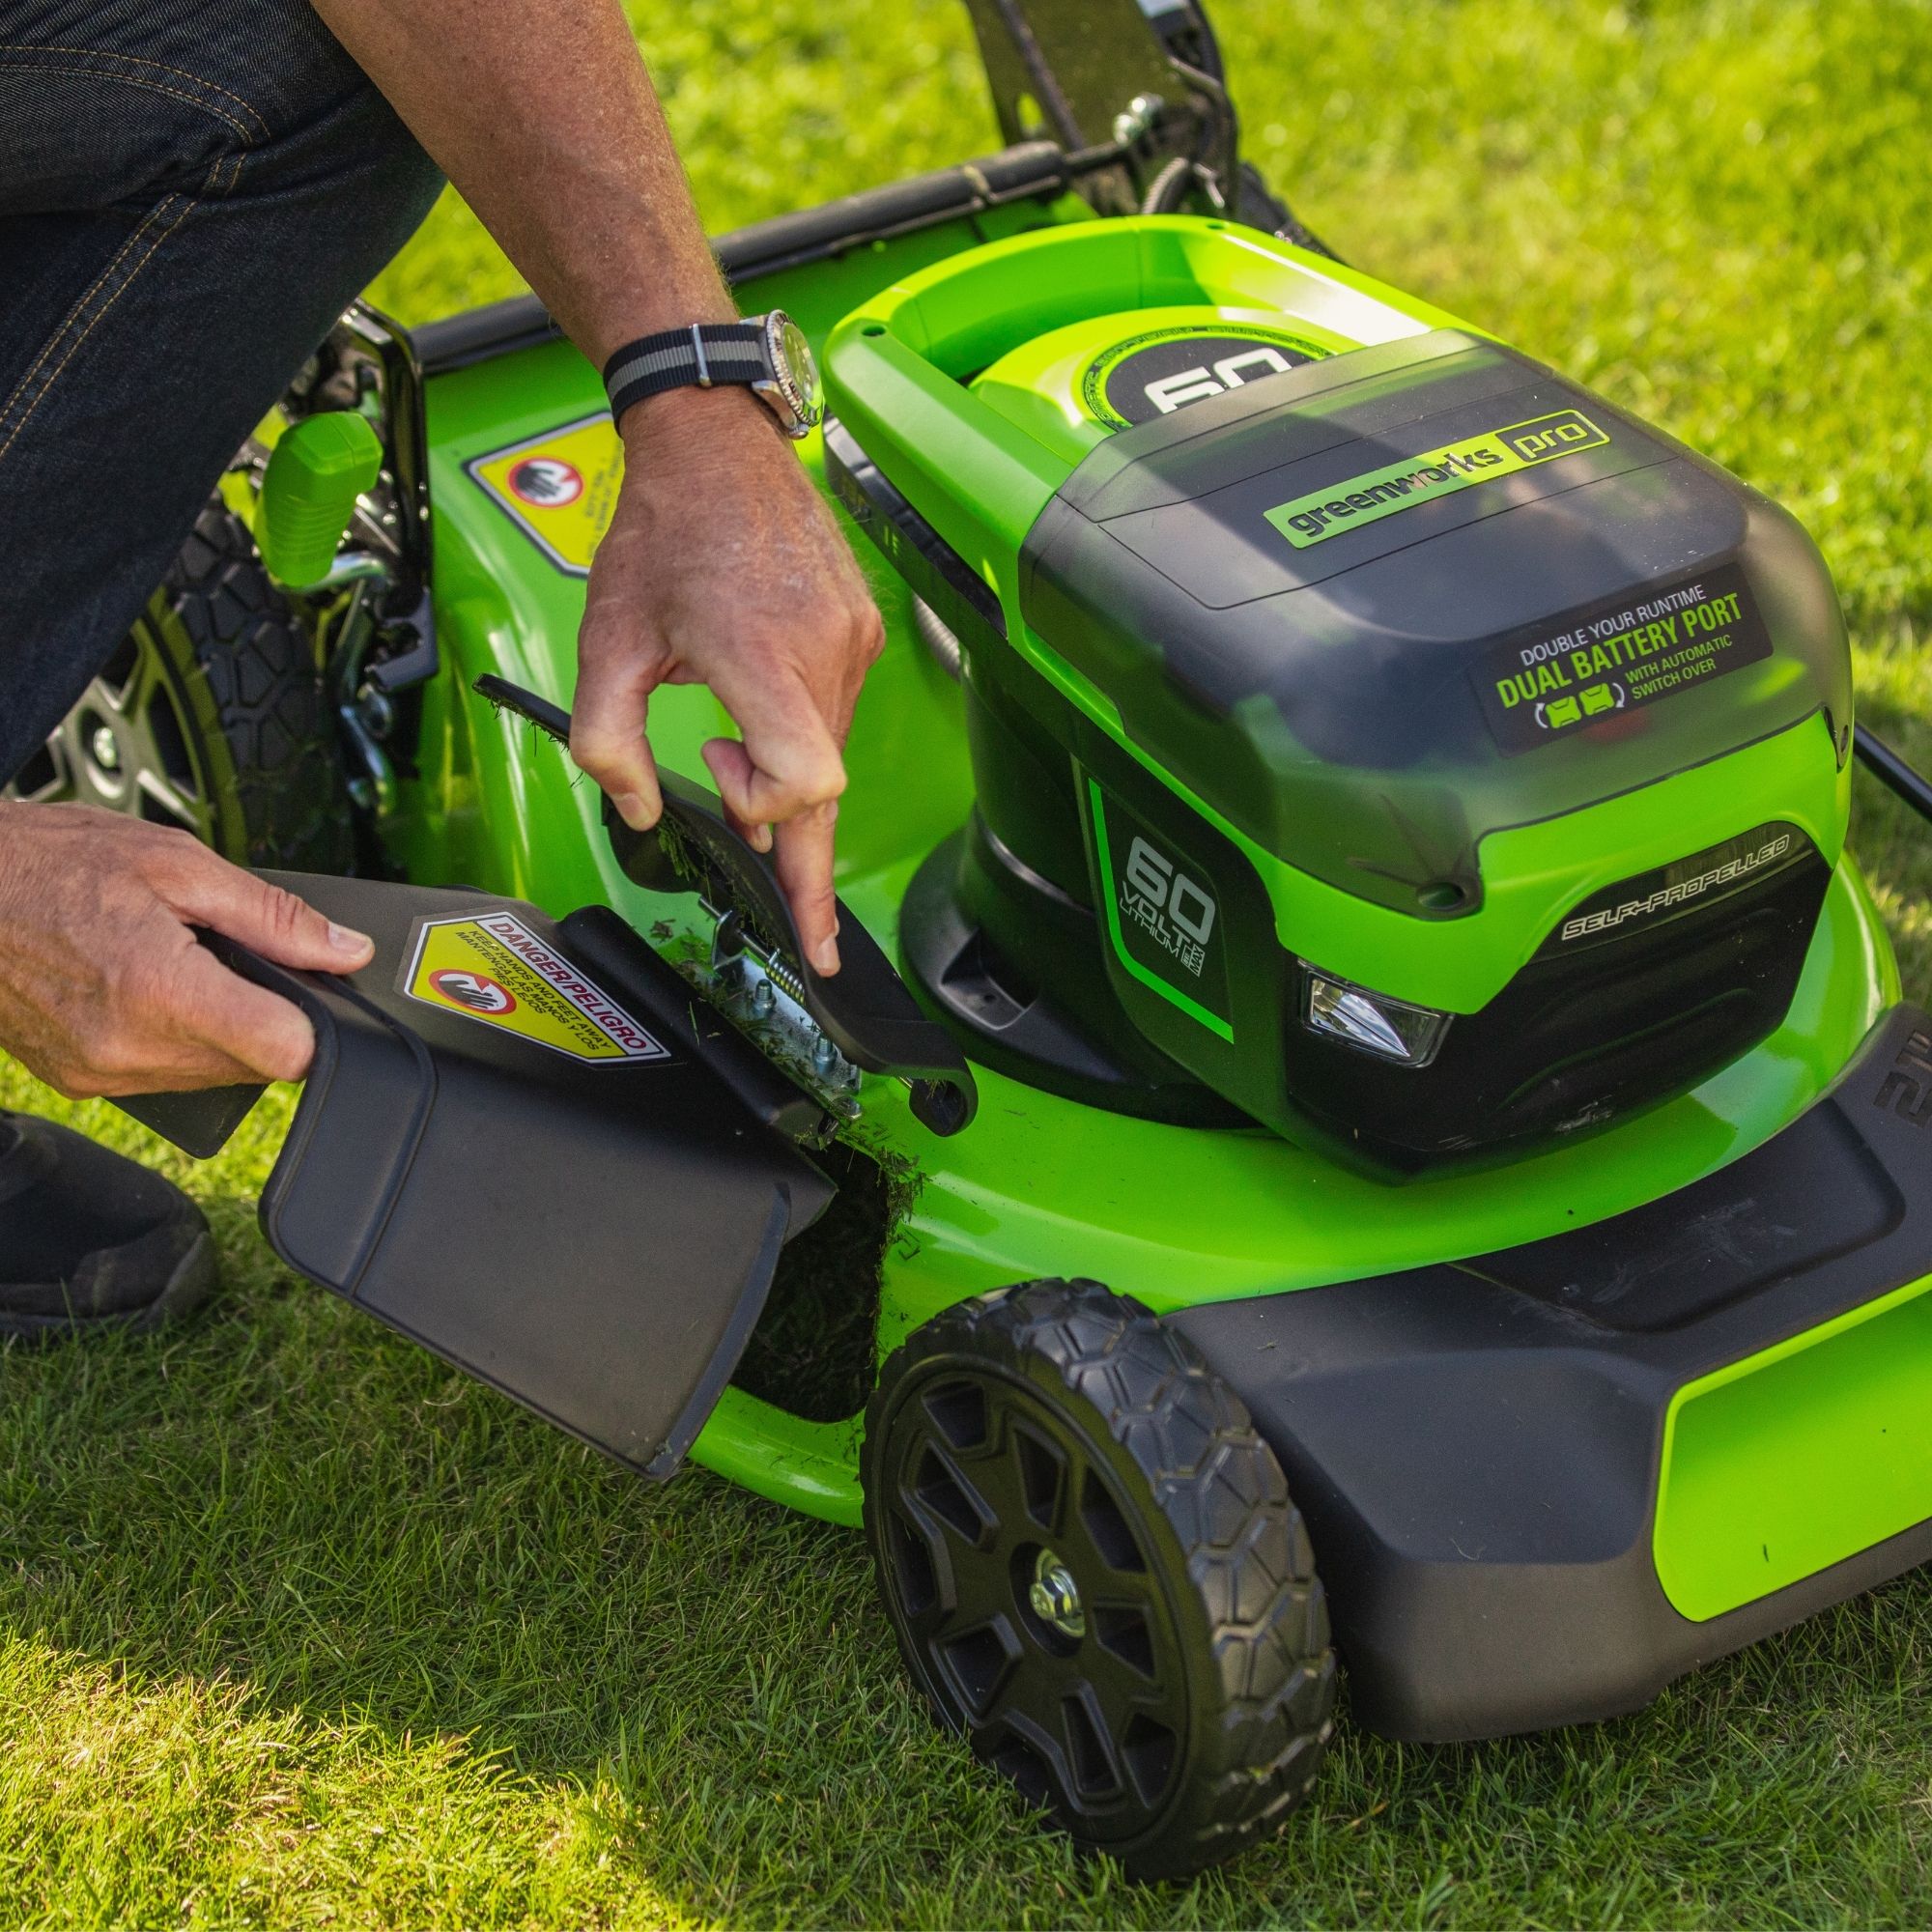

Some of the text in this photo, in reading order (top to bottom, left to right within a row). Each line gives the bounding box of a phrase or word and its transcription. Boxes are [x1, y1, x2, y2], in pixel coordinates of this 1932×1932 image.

[1288, 422, 1588, 537] greenworks pro
[1496, 592, 1743, 709] DUAL BATTERY PORT
[1520, 584, 1707, 667] DOUBLE YOUR RUNTIME
[1625, 635, 1733, 684] WITH AUTOMATIC
[1632, 659, 1717, 699] SWITCH OVER
[1120, 897, 1179, 957] LITHIUM
[1122, 881, 1191, 948] VOLT
[1127, 836, 1215, 945] 60
[1562, 835, 1789, 940] SELF-PROPELLED
[456, 931, 512, 975] MANTENGA
[510, 976, 533, 992] LAS
[530, 993, 570, 1024] MANOS
[575, 1032, 599, 1050] LOS
[469, 930, 611, 1048] KEEP HANDS AND FEET AWAY
[488, 967, 547, 1013] PIES LEJOS
[489, 923, 647, 1050] DANGER/PELIGRO
